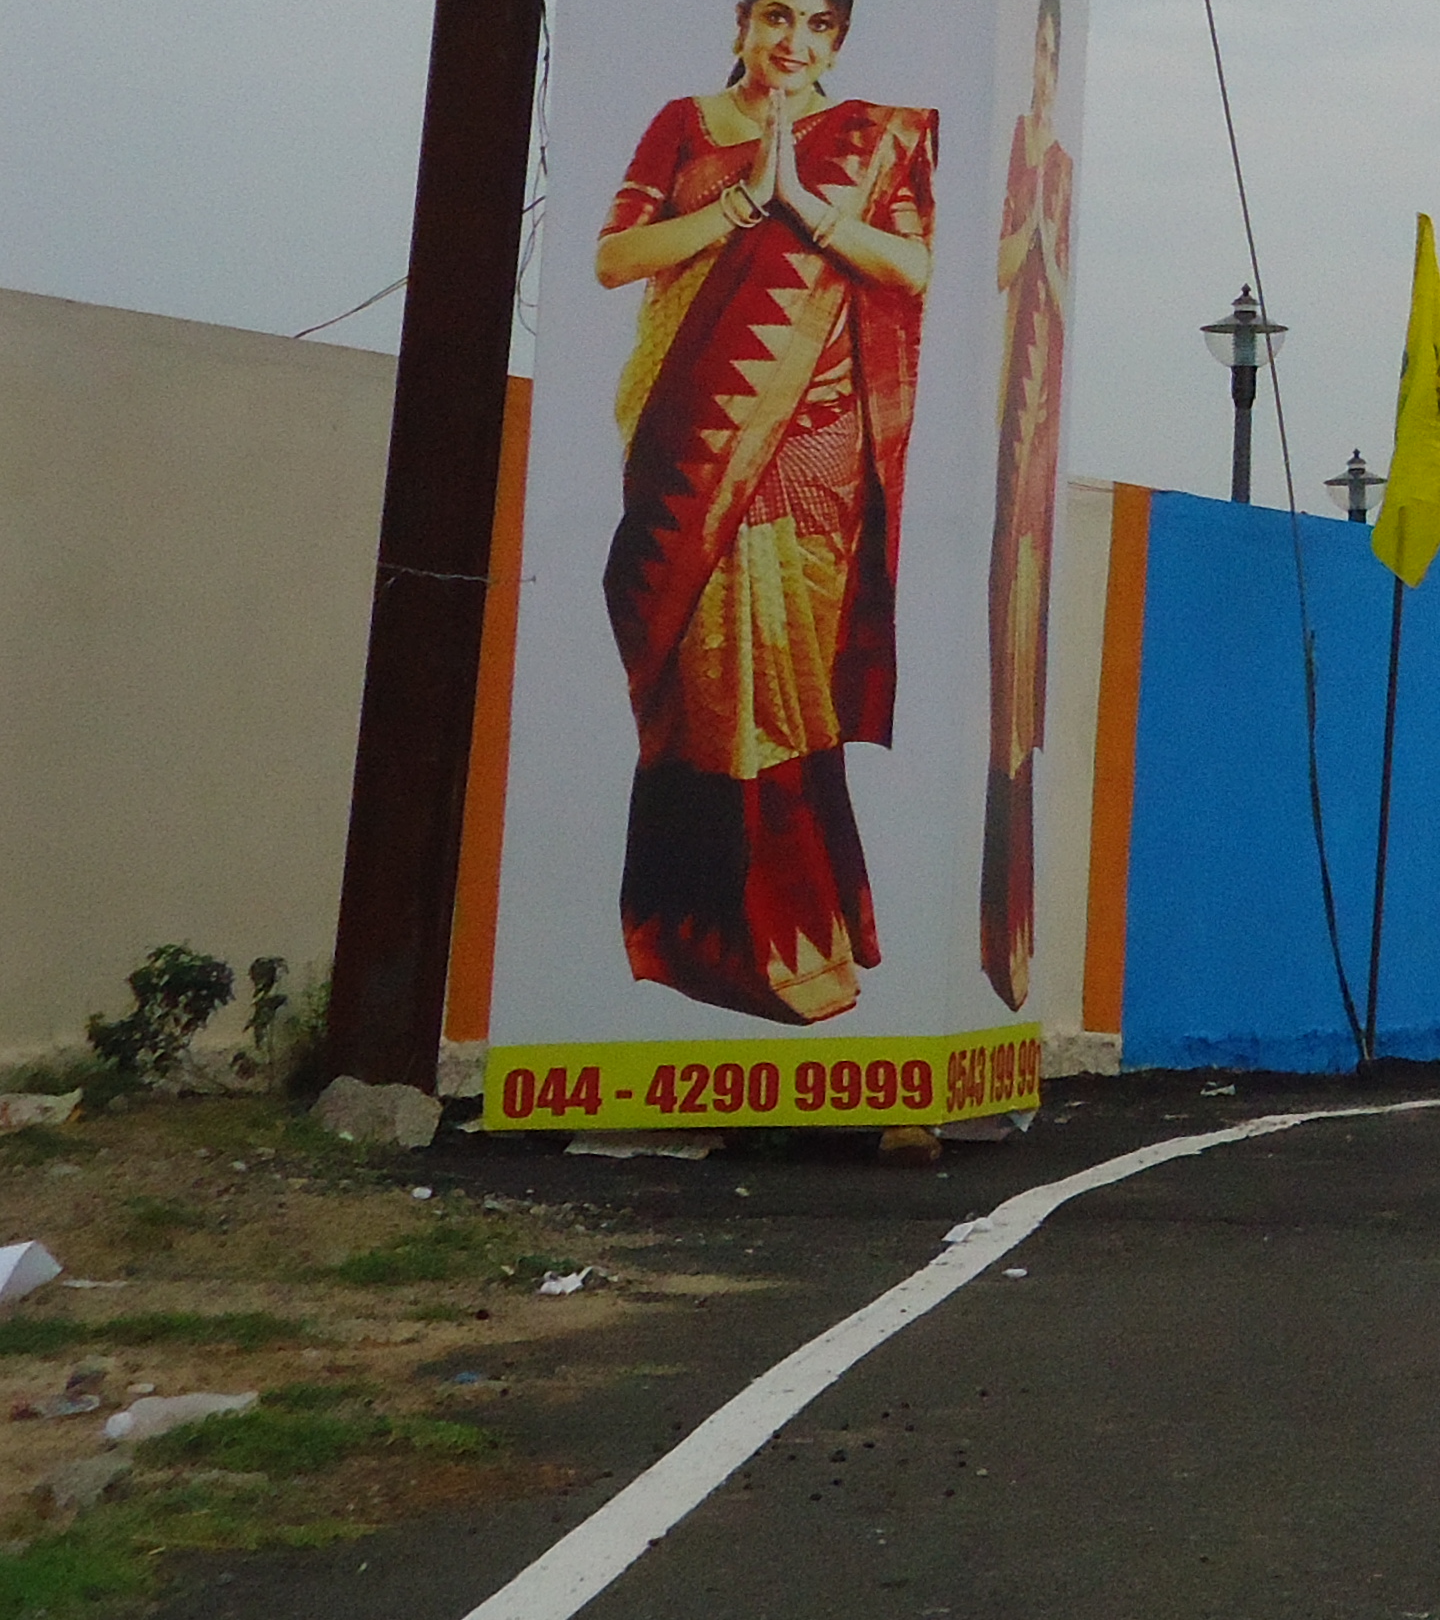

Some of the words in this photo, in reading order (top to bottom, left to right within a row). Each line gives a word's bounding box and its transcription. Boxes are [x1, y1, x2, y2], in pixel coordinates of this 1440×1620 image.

[502, 1065, 602, 1119] 044
[645, 1061, 780, 1114] 4290
[794, 1059, 933, 1112] 9999
